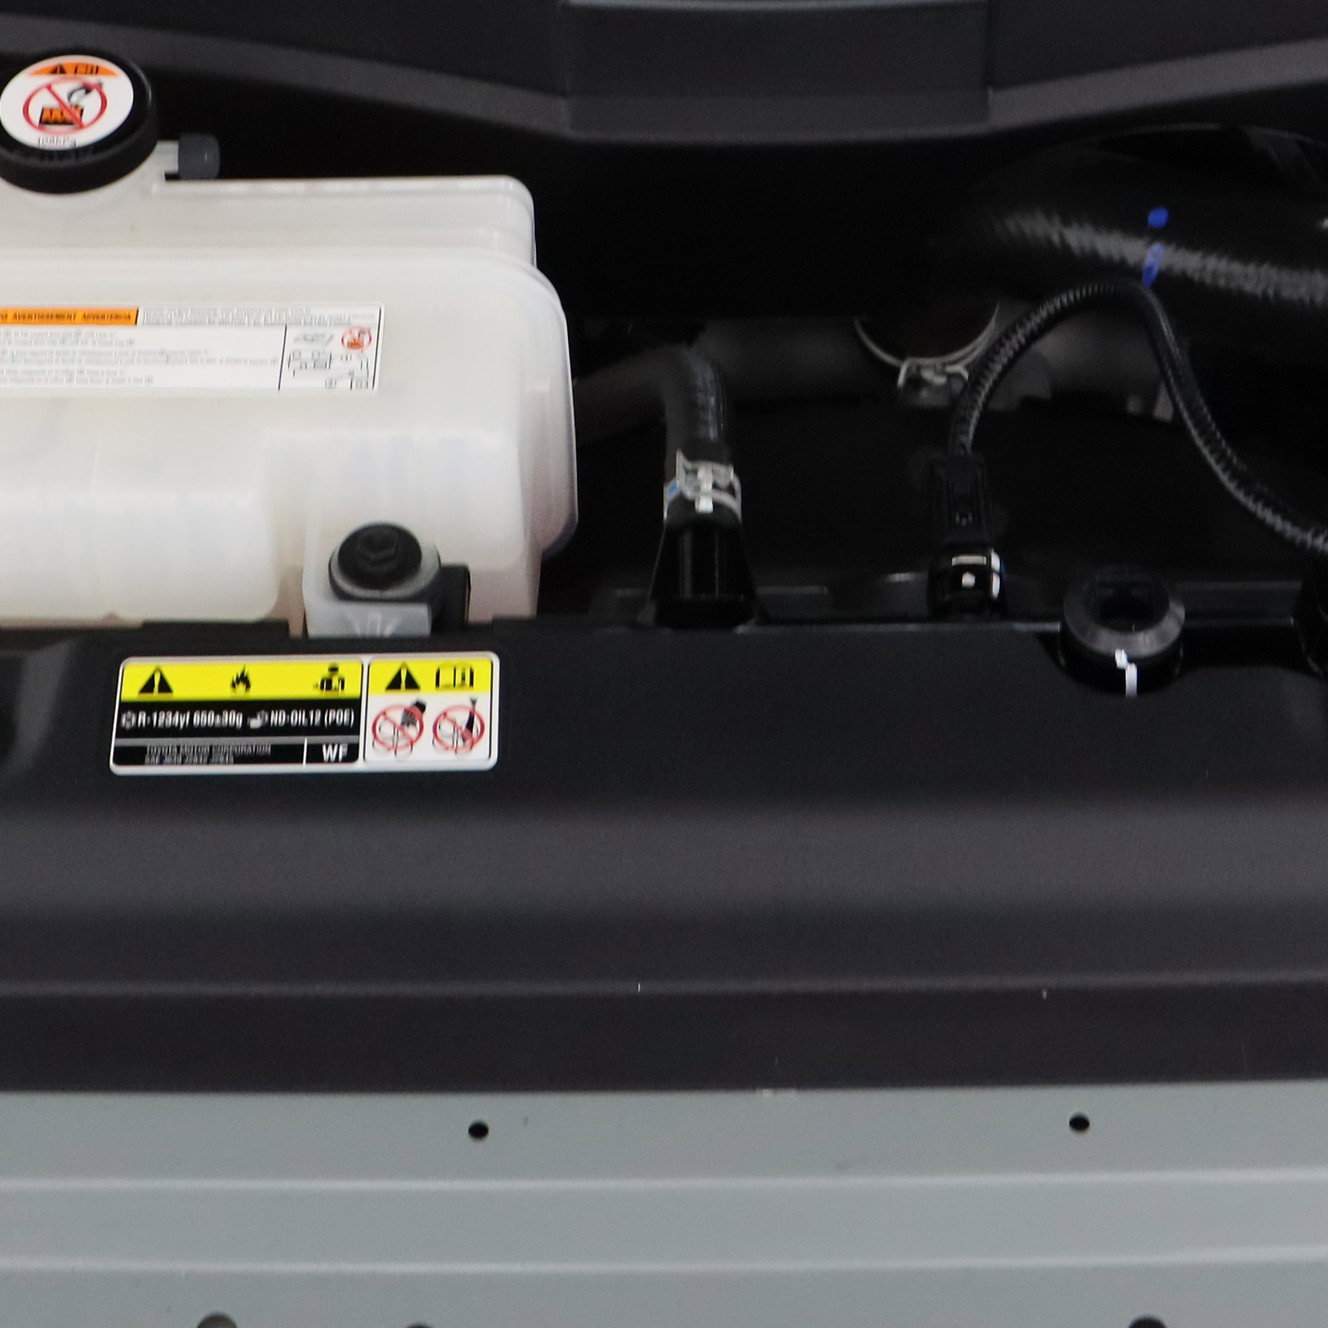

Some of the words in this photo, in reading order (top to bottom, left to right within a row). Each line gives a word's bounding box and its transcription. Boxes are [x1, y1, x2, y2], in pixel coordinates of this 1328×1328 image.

[138, 710, 190, 730] R-1234yf
[324, 708, 354, 728] (POE)
[322, 744, 349, 762] WF
